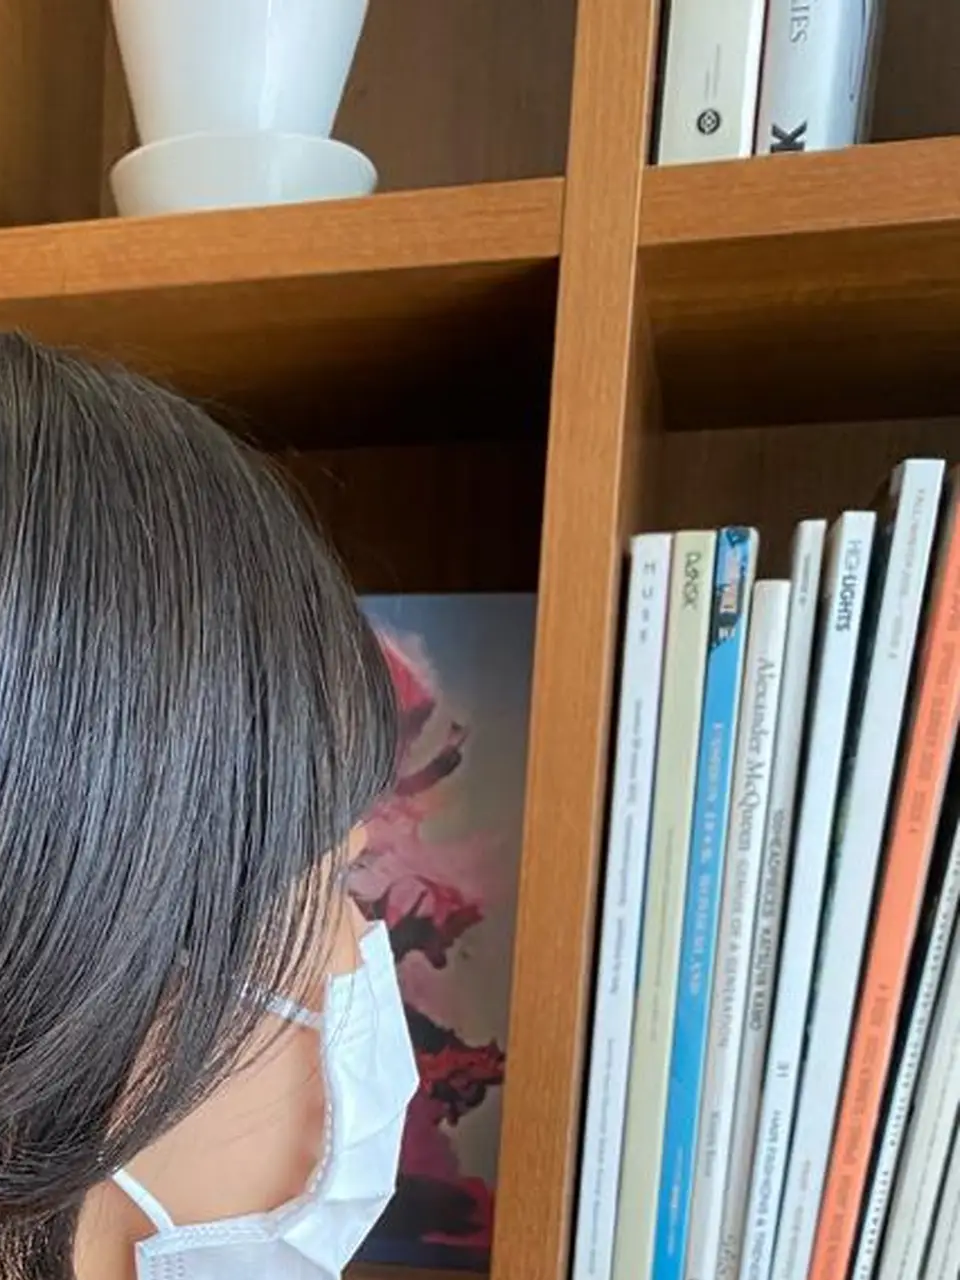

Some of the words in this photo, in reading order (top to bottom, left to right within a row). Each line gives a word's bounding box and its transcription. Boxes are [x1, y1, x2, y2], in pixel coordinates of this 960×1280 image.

[790, 0, 810, 43] IES
[748, 657, 776, 754] Alexander
[737, 759, 766, 852] McQueen
